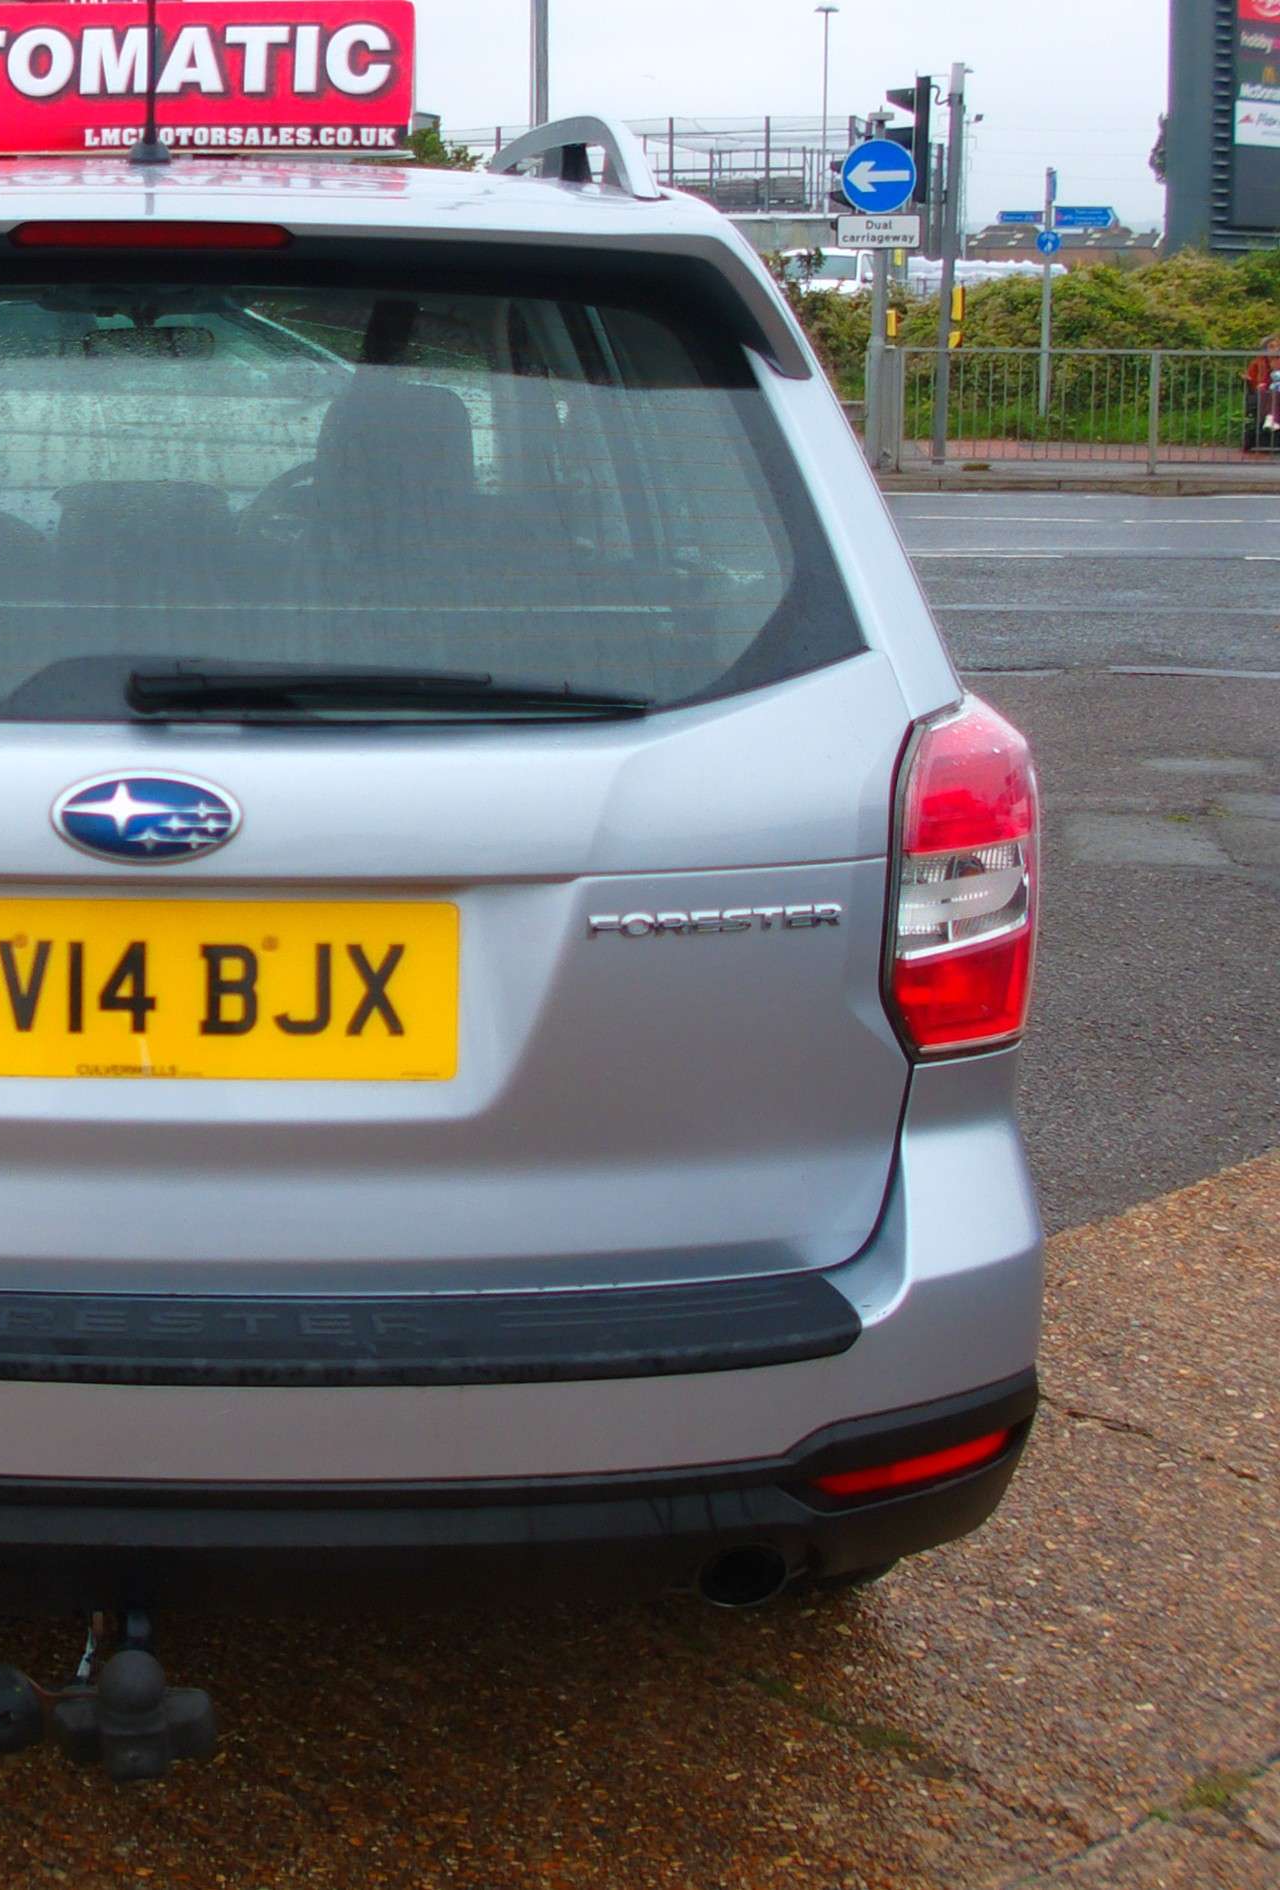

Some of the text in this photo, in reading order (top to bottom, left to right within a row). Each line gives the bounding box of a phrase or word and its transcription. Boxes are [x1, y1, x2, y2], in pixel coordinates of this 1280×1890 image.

[865, 220, 893, 230] Dual
[842, 233, 915, 244] carriageway
[587, 902, 843, 940] FORESTER
[197, 941, 408, 1038] BJX
